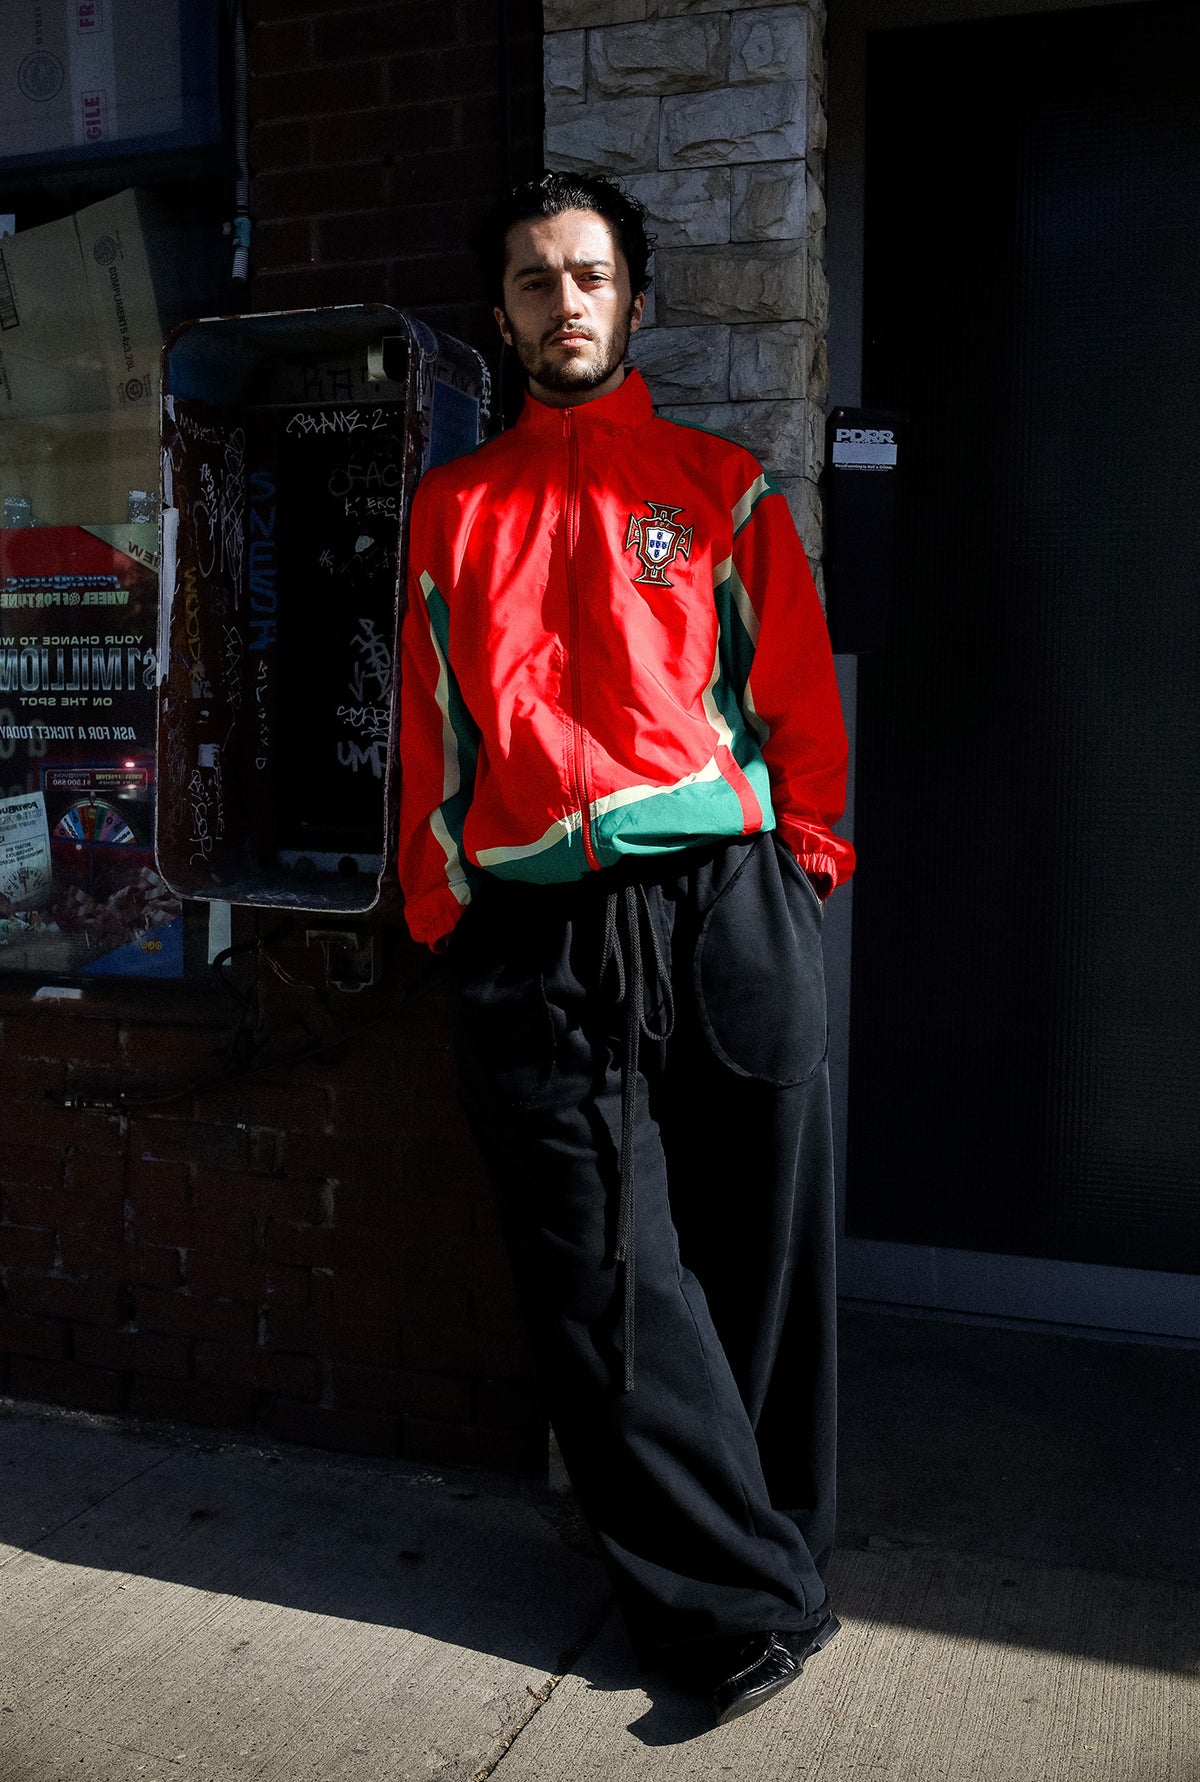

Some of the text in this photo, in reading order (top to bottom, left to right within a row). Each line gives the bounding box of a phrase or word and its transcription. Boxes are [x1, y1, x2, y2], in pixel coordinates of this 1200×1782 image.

[79, 0, 95, 27] FR
[108, 267, 128, 334] COMPLIMENTS
[836, 428, 895, 443] PDRR
